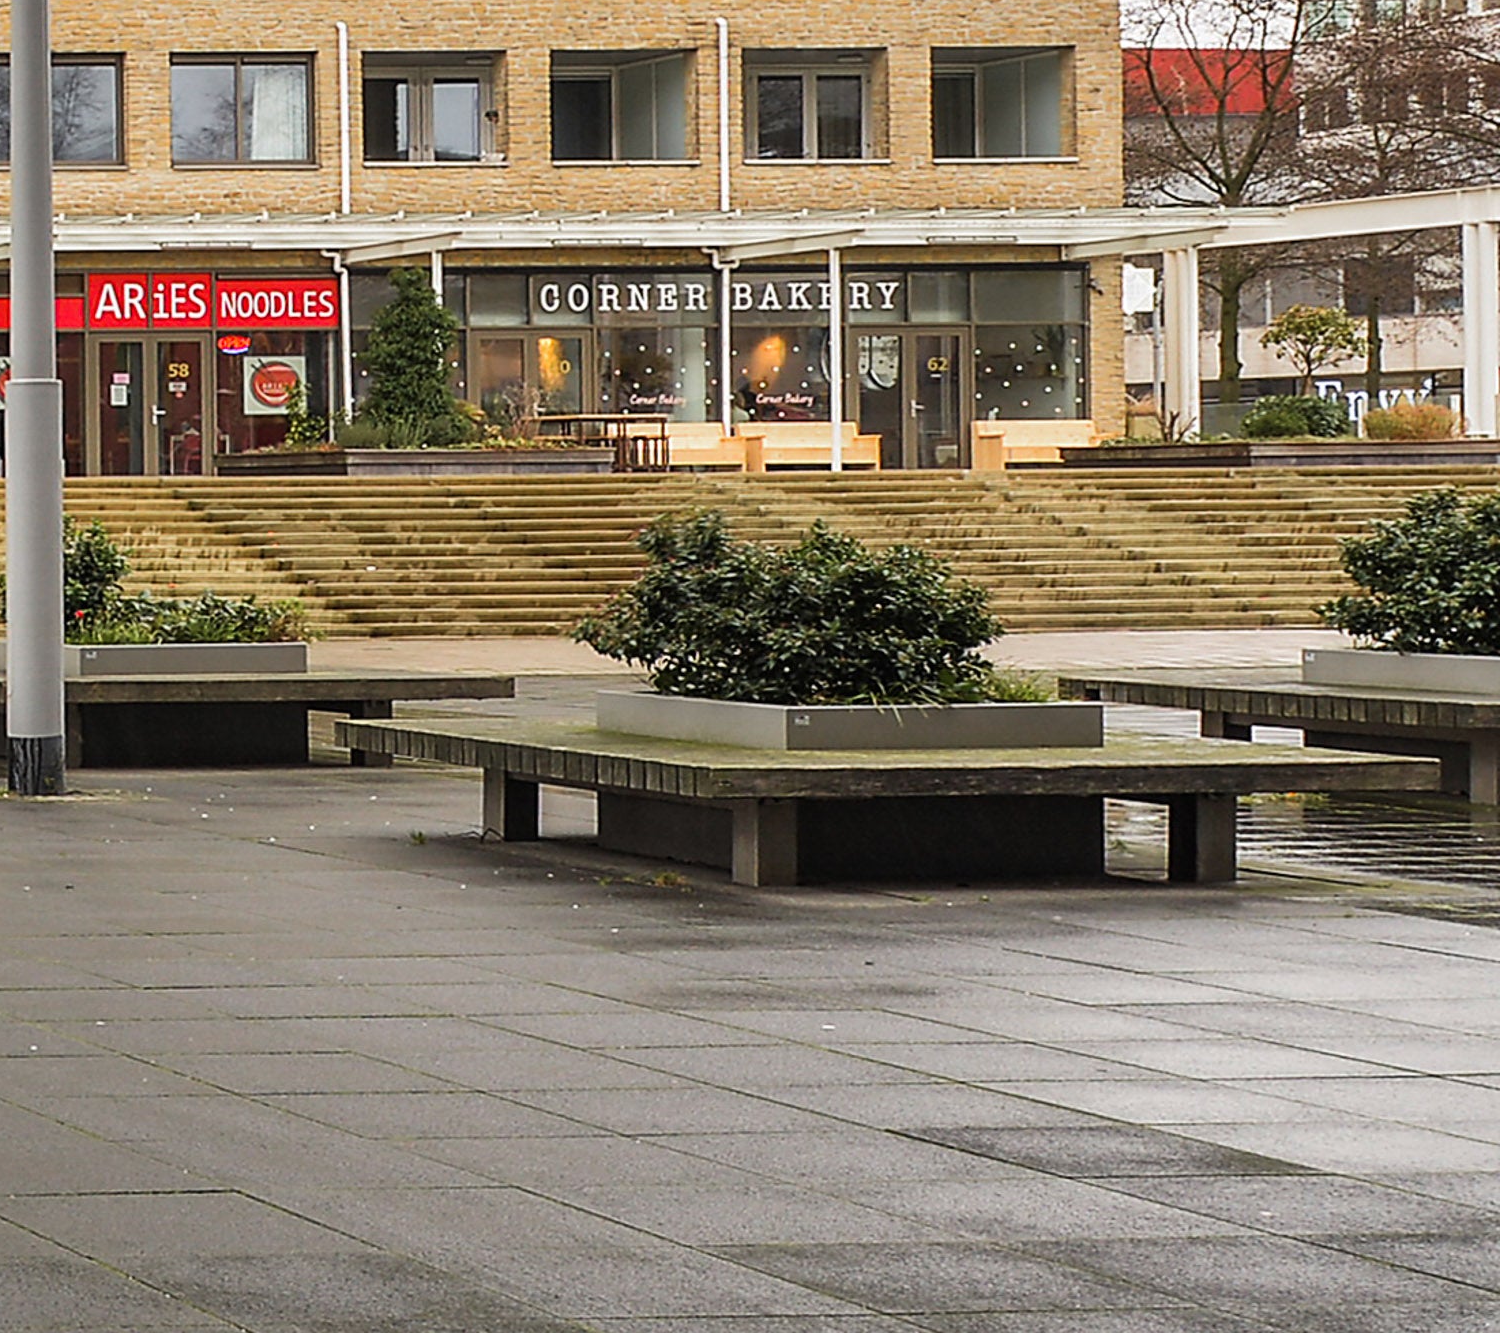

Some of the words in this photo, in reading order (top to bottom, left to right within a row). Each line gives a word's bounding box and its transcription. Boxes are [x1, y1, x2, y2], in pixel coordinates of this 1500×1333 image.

[220, 291, 335, 318] NOODLES
[539, 283, 708, 312] CORNER
[167, 362, 191, 379] 58
[927, 356, 949, 372] 62
